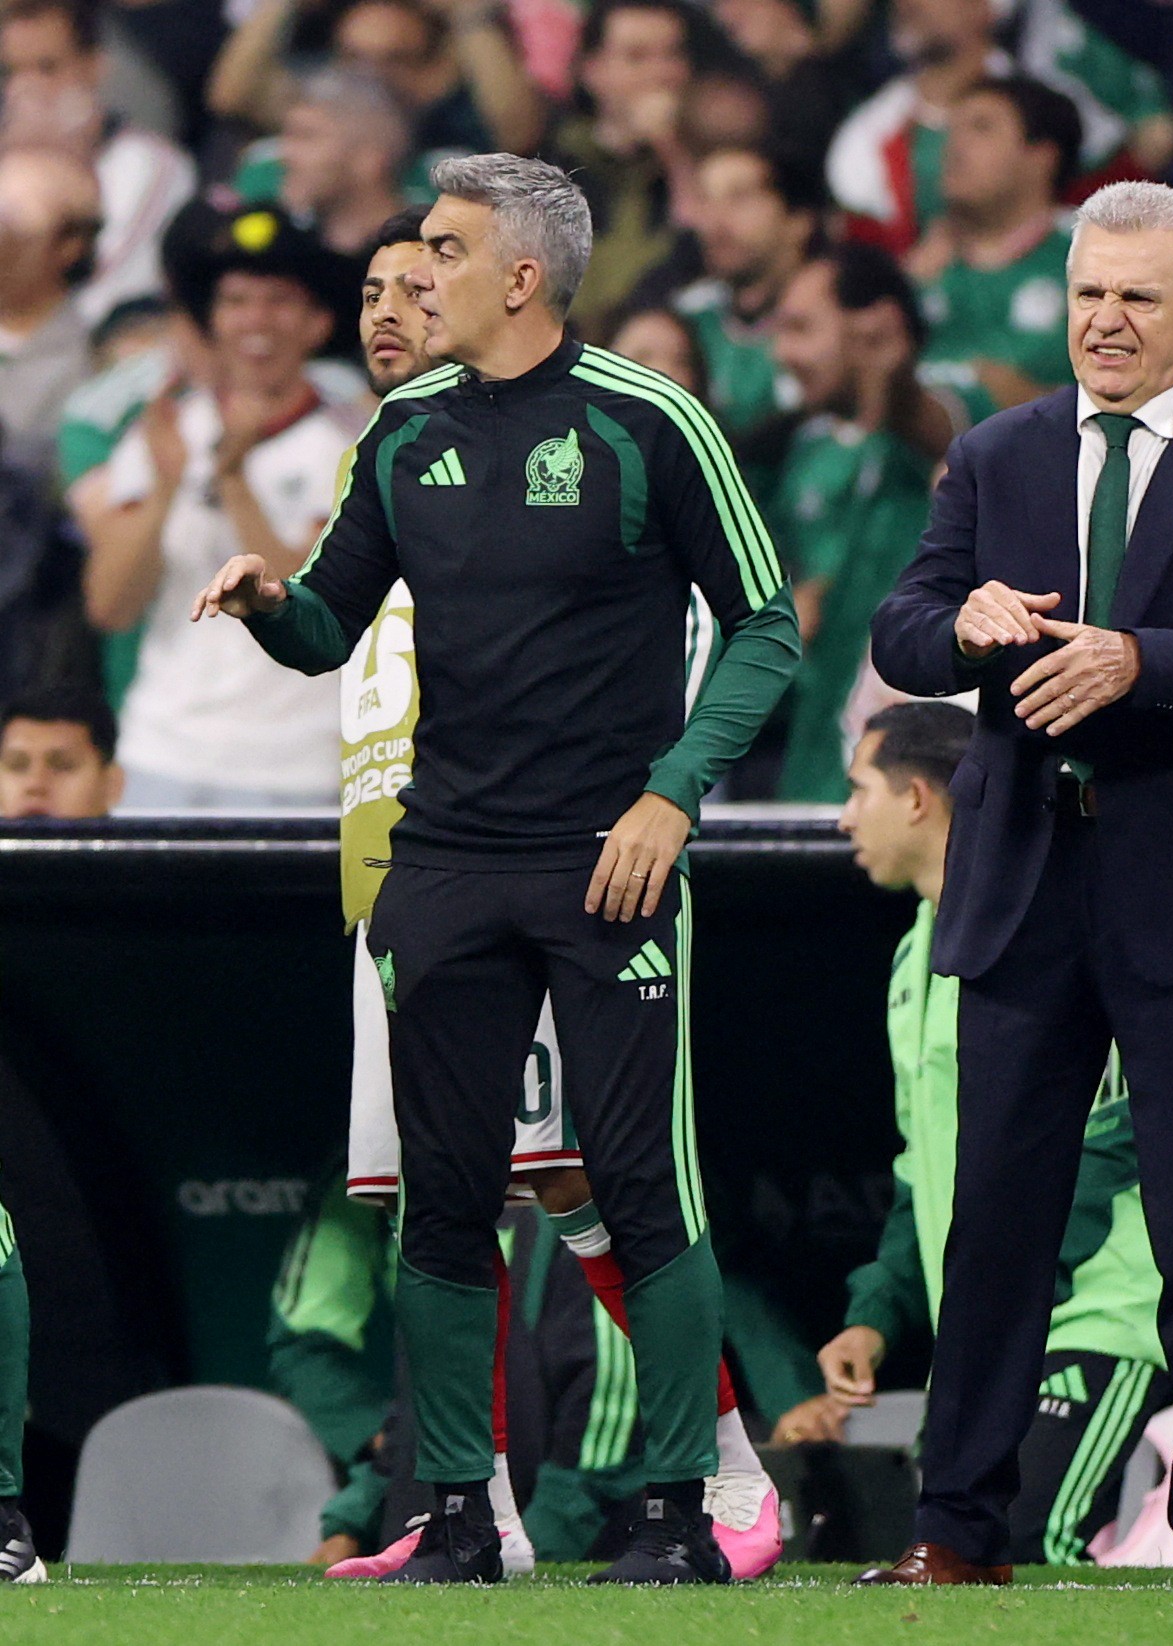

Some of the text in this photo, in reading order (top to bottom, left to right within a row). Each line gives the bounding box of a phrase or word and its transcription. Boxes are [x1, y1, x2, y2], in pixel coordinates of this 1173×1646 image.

[529, 490, 577, 503] MÉXICO
[372, 737, 412, 762] CUP
[514, 1040, 552, 1125] 0
[178, 1180, 309, 1215] aram
